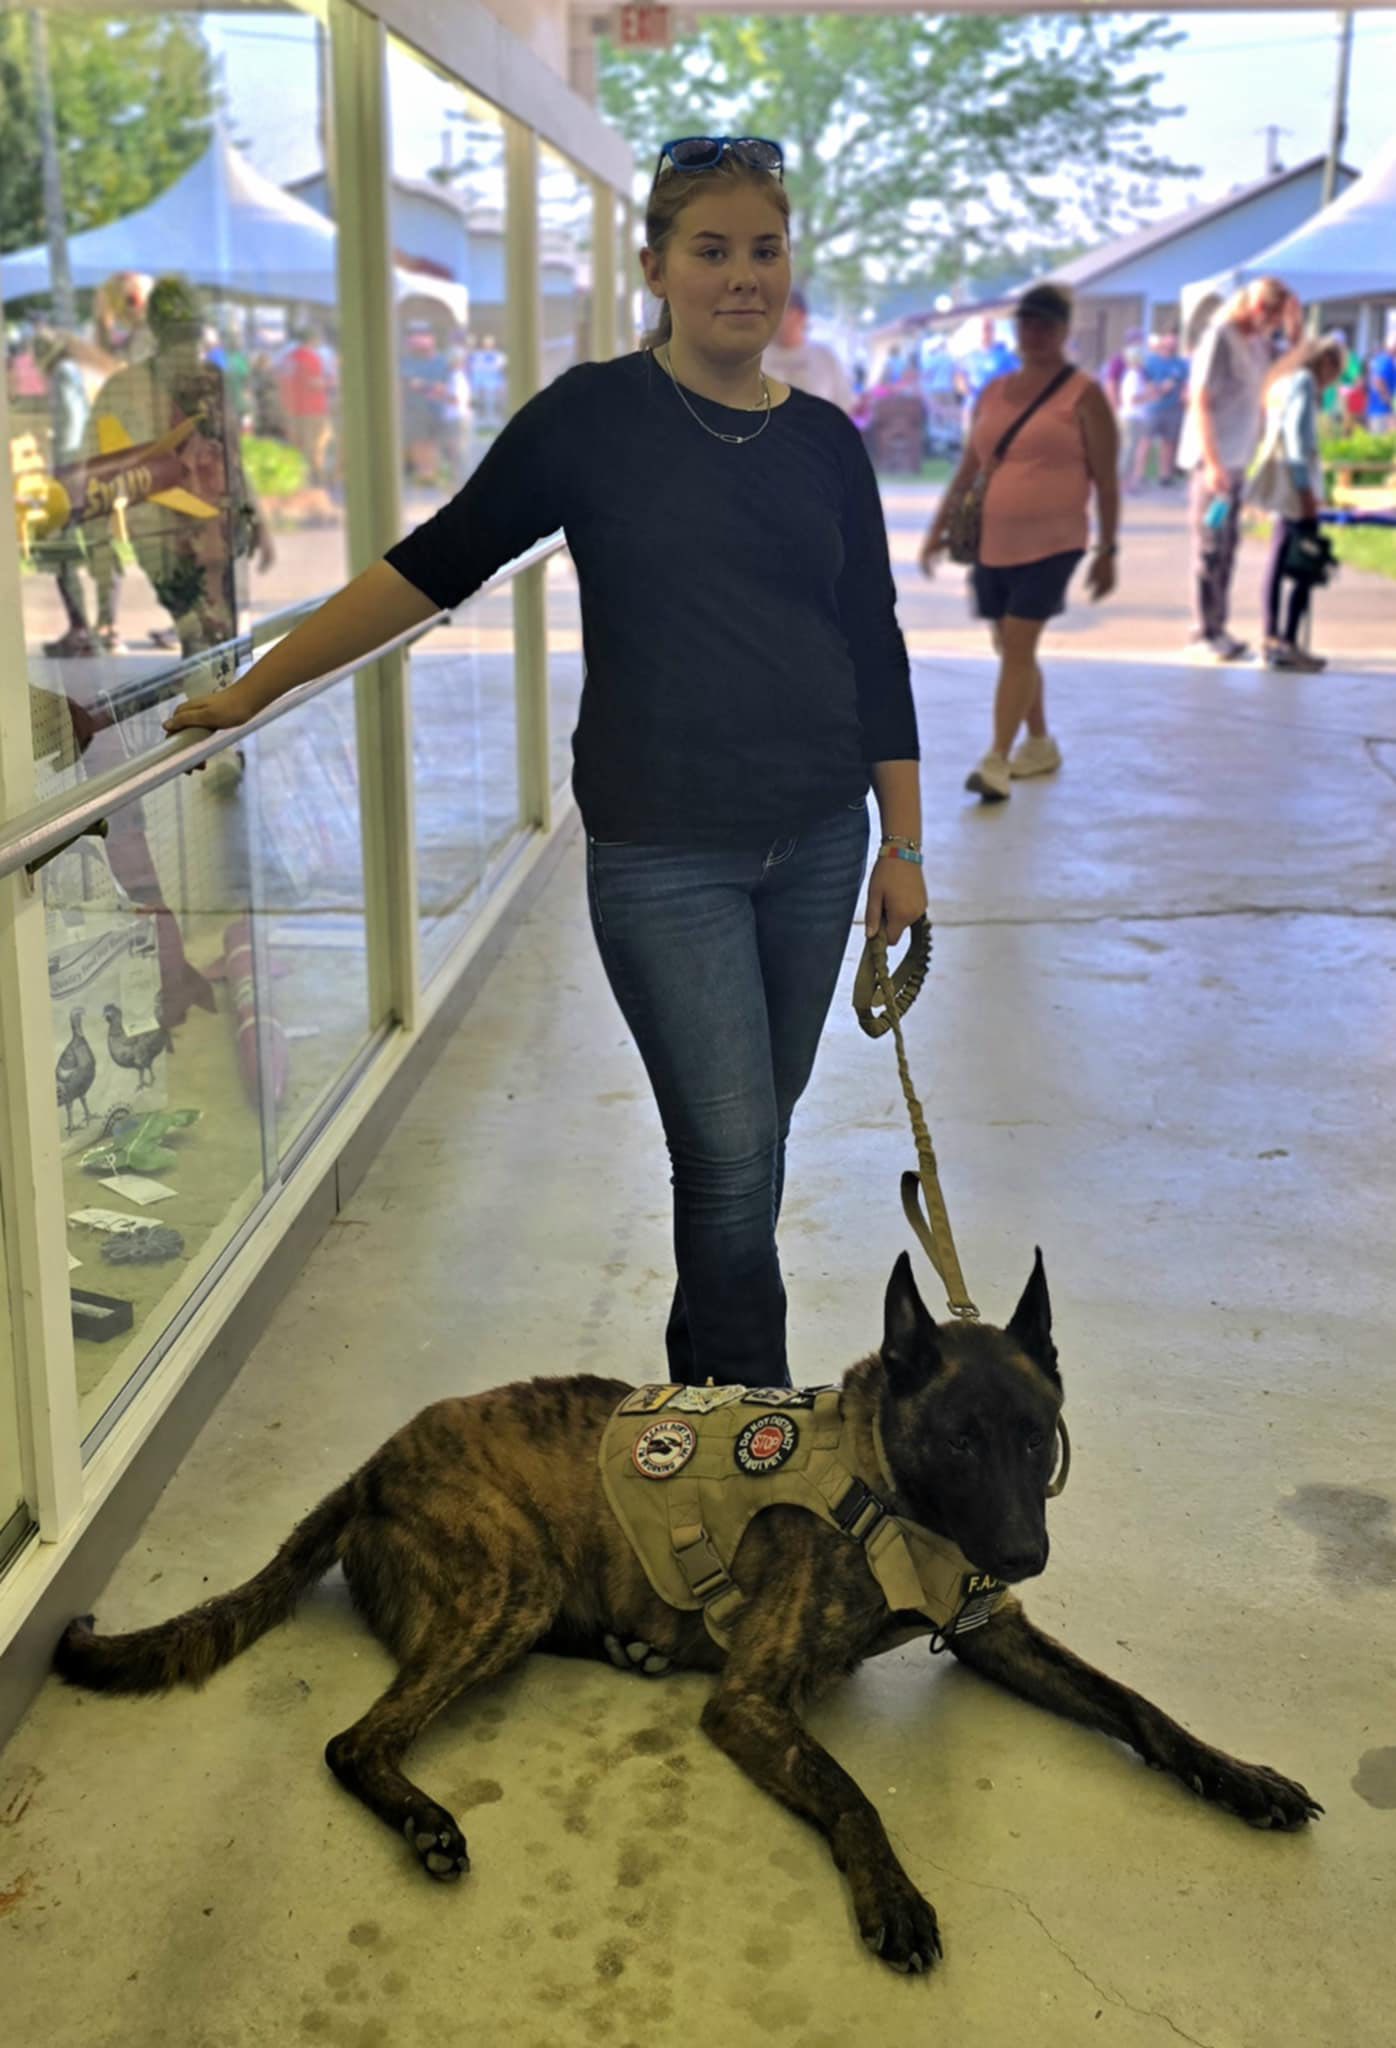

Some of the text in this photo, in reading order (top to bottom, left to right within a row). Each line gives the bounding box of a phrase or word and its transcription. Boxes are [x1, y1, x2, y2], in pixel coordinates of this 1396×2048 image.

[739, 1414, 795, 1450] DO NOT DISTRACT
[751, 1433, 781, 1451] STOP
[738, 1448, 784, 1471] DO NOT PET
